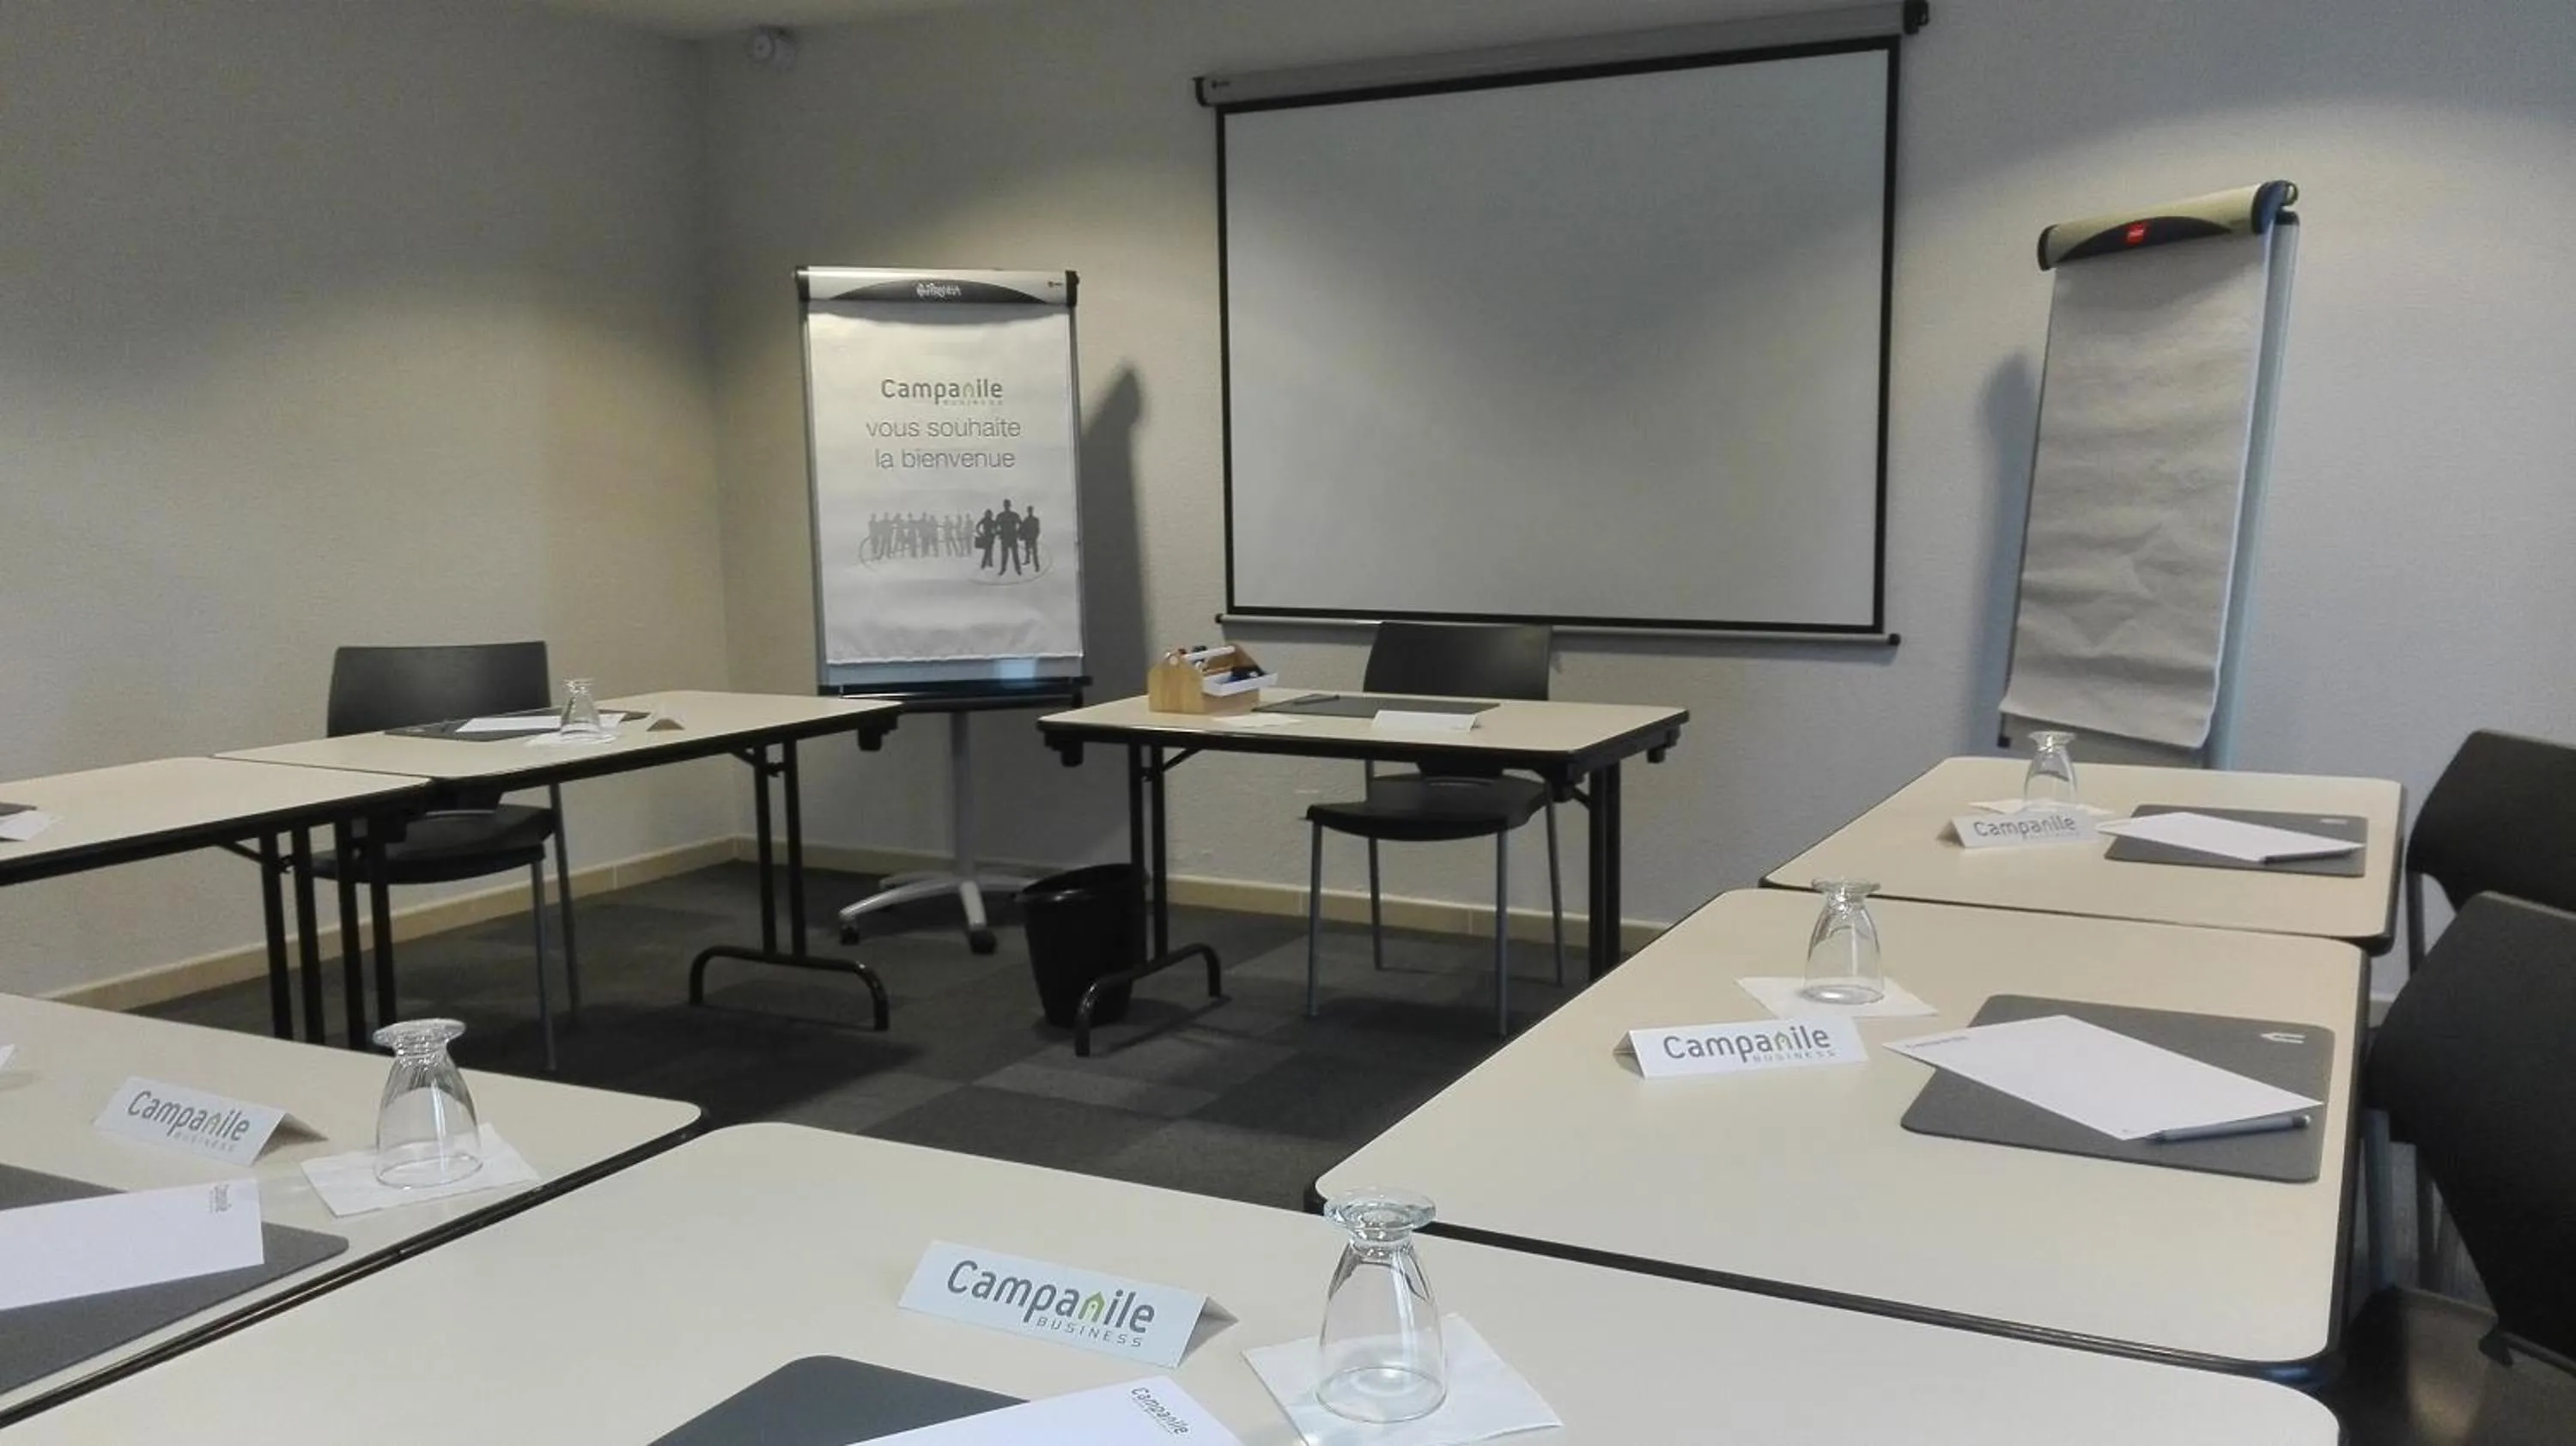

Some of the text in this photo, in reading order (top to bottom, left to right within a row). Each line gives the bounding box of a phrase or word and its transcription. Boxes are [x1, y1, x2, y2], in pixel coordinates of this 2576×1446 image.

[881, 379, 1004, 405] Campanile
[866, 416, 1021, 437] vous souhaite
[875, 448, 1016, 469] la bienvenue
[1973, 815, 2076, 839] Campanile
[1663, 1025, 1832, 1063] Campanile
[128, 1090, 250, 1141] Campanile
[947, 1260, 1156, 1334] Campanile
[1036, 1316, 1143, 1348] BUSINESS
